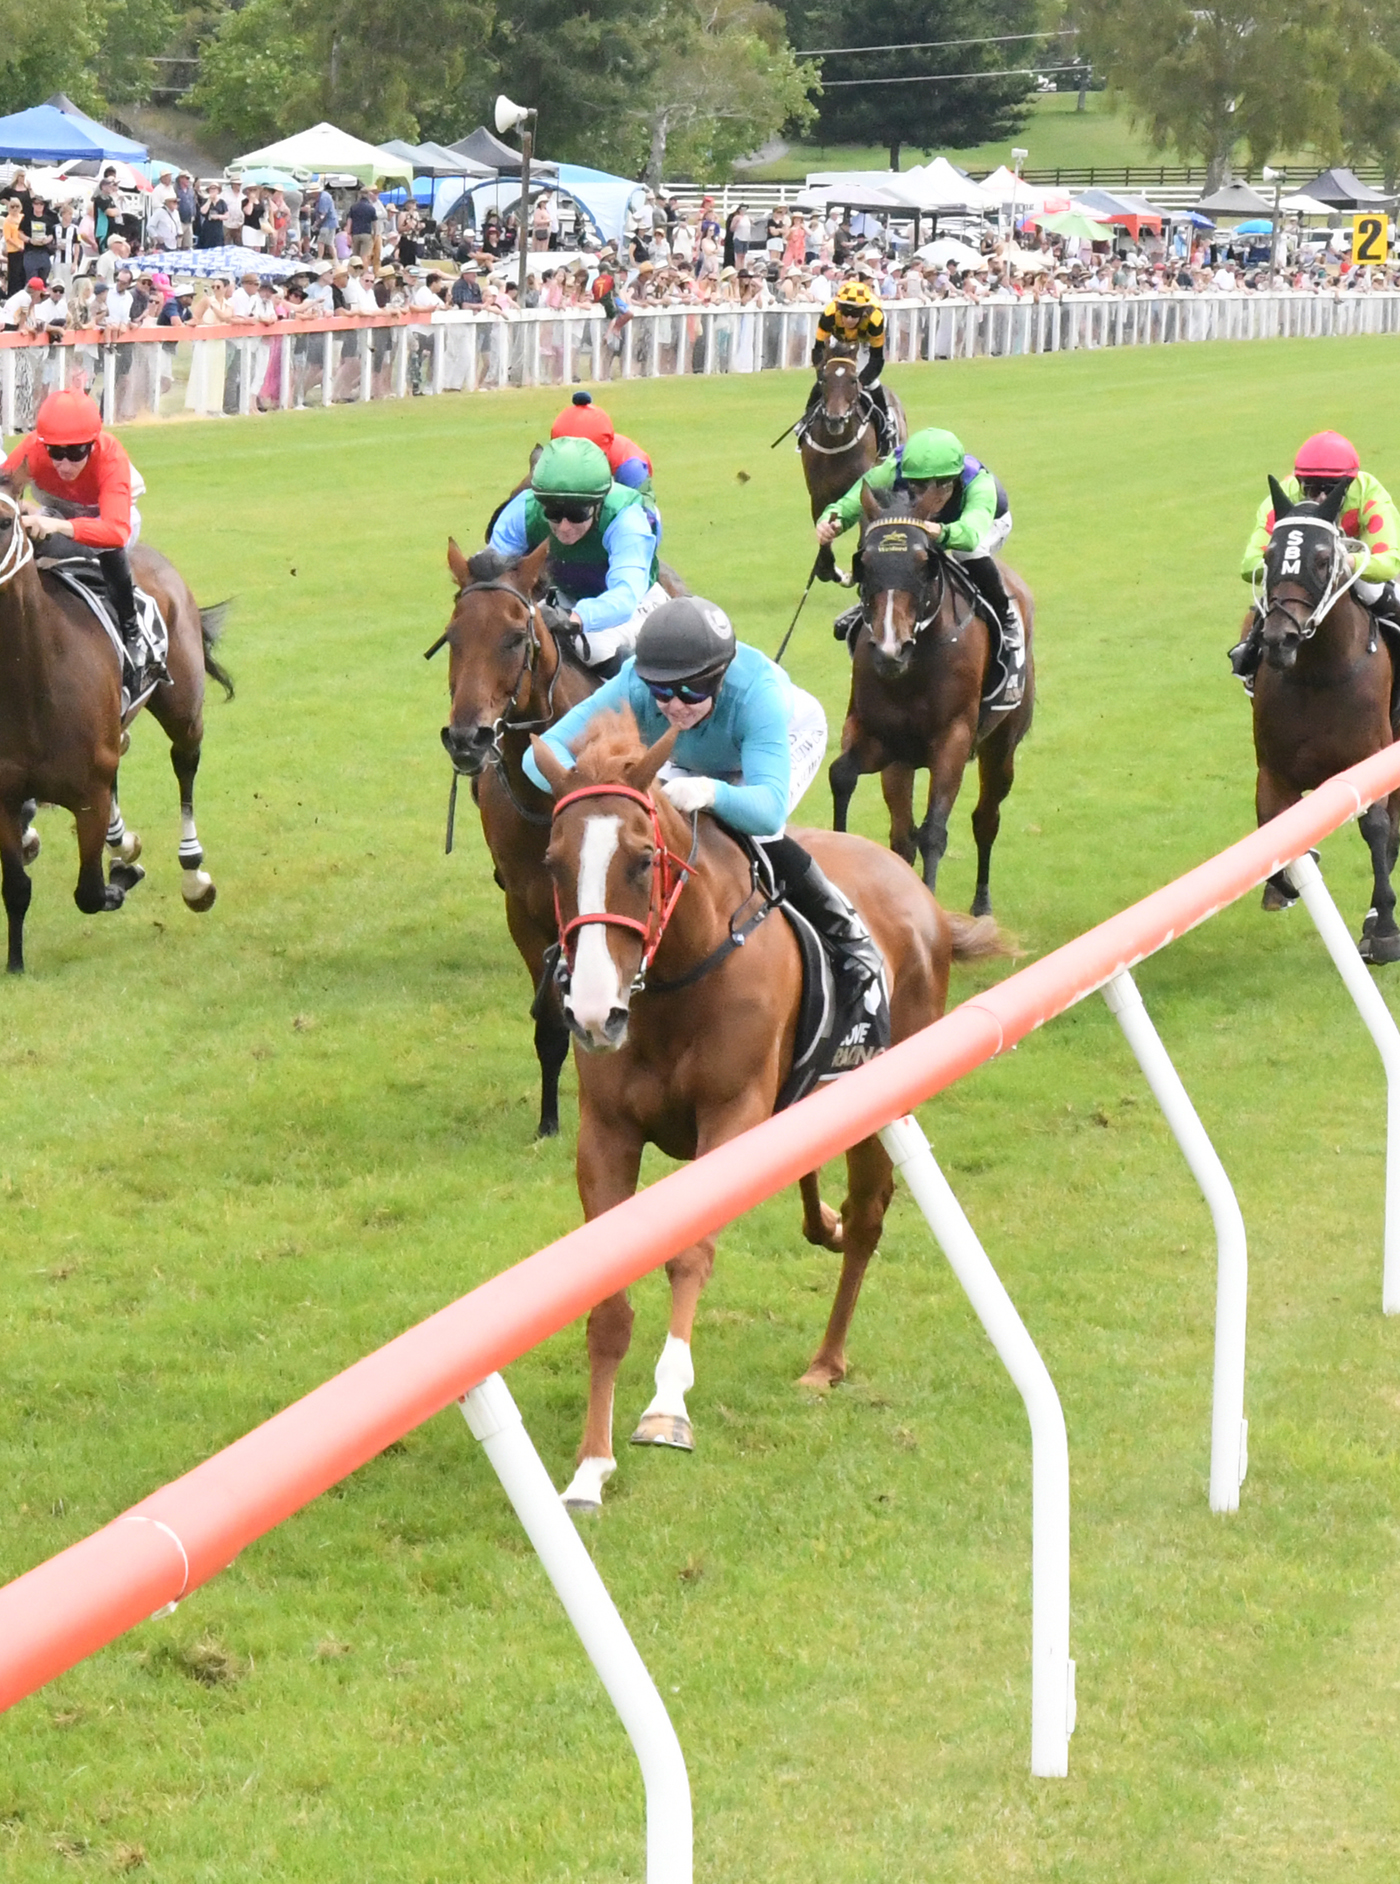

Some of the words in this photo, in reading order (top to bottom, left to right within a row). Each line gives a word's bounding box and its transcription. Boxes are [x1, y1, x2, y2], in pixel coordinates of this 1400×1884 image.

[1357, 219, 1382, 260] 2
[1281, 530, 1304, 575] SBM
[840, 1022, 871, 1046] OVE
